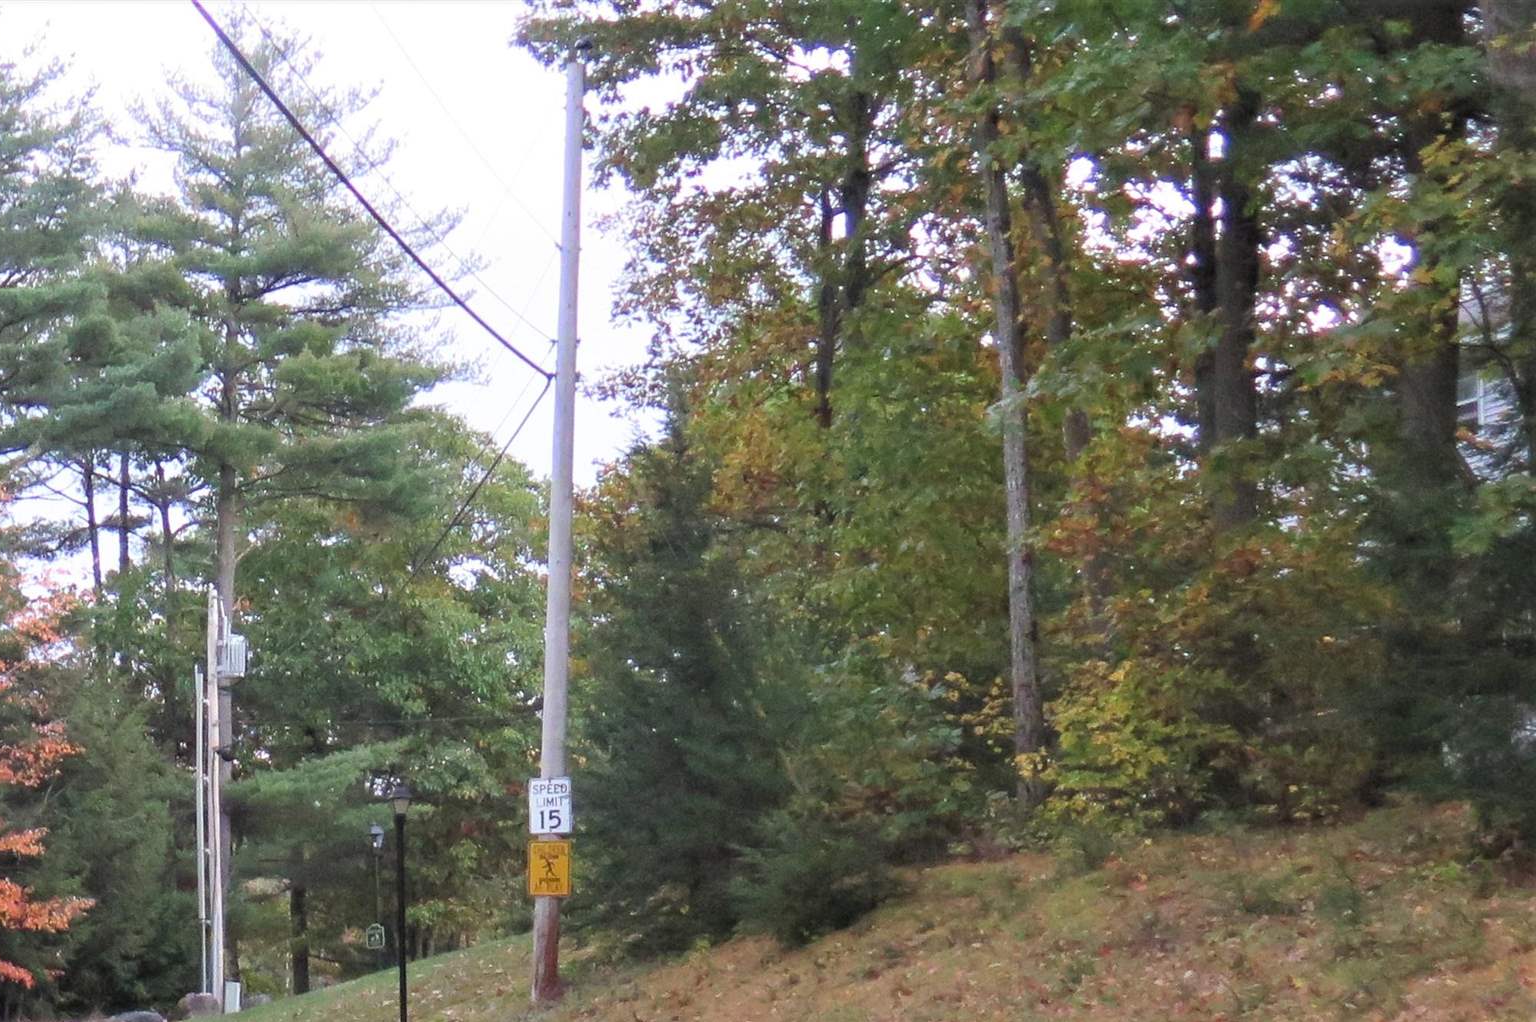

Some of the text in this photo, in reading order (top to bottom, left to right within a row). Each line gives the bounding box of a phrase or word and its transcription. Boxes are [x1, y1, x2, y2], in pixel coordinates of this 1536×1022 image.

[532, 784, 568, 794] SPEED
[536, 796, 565, 807] LIMIT
[539, 809, 562, 829] 15
